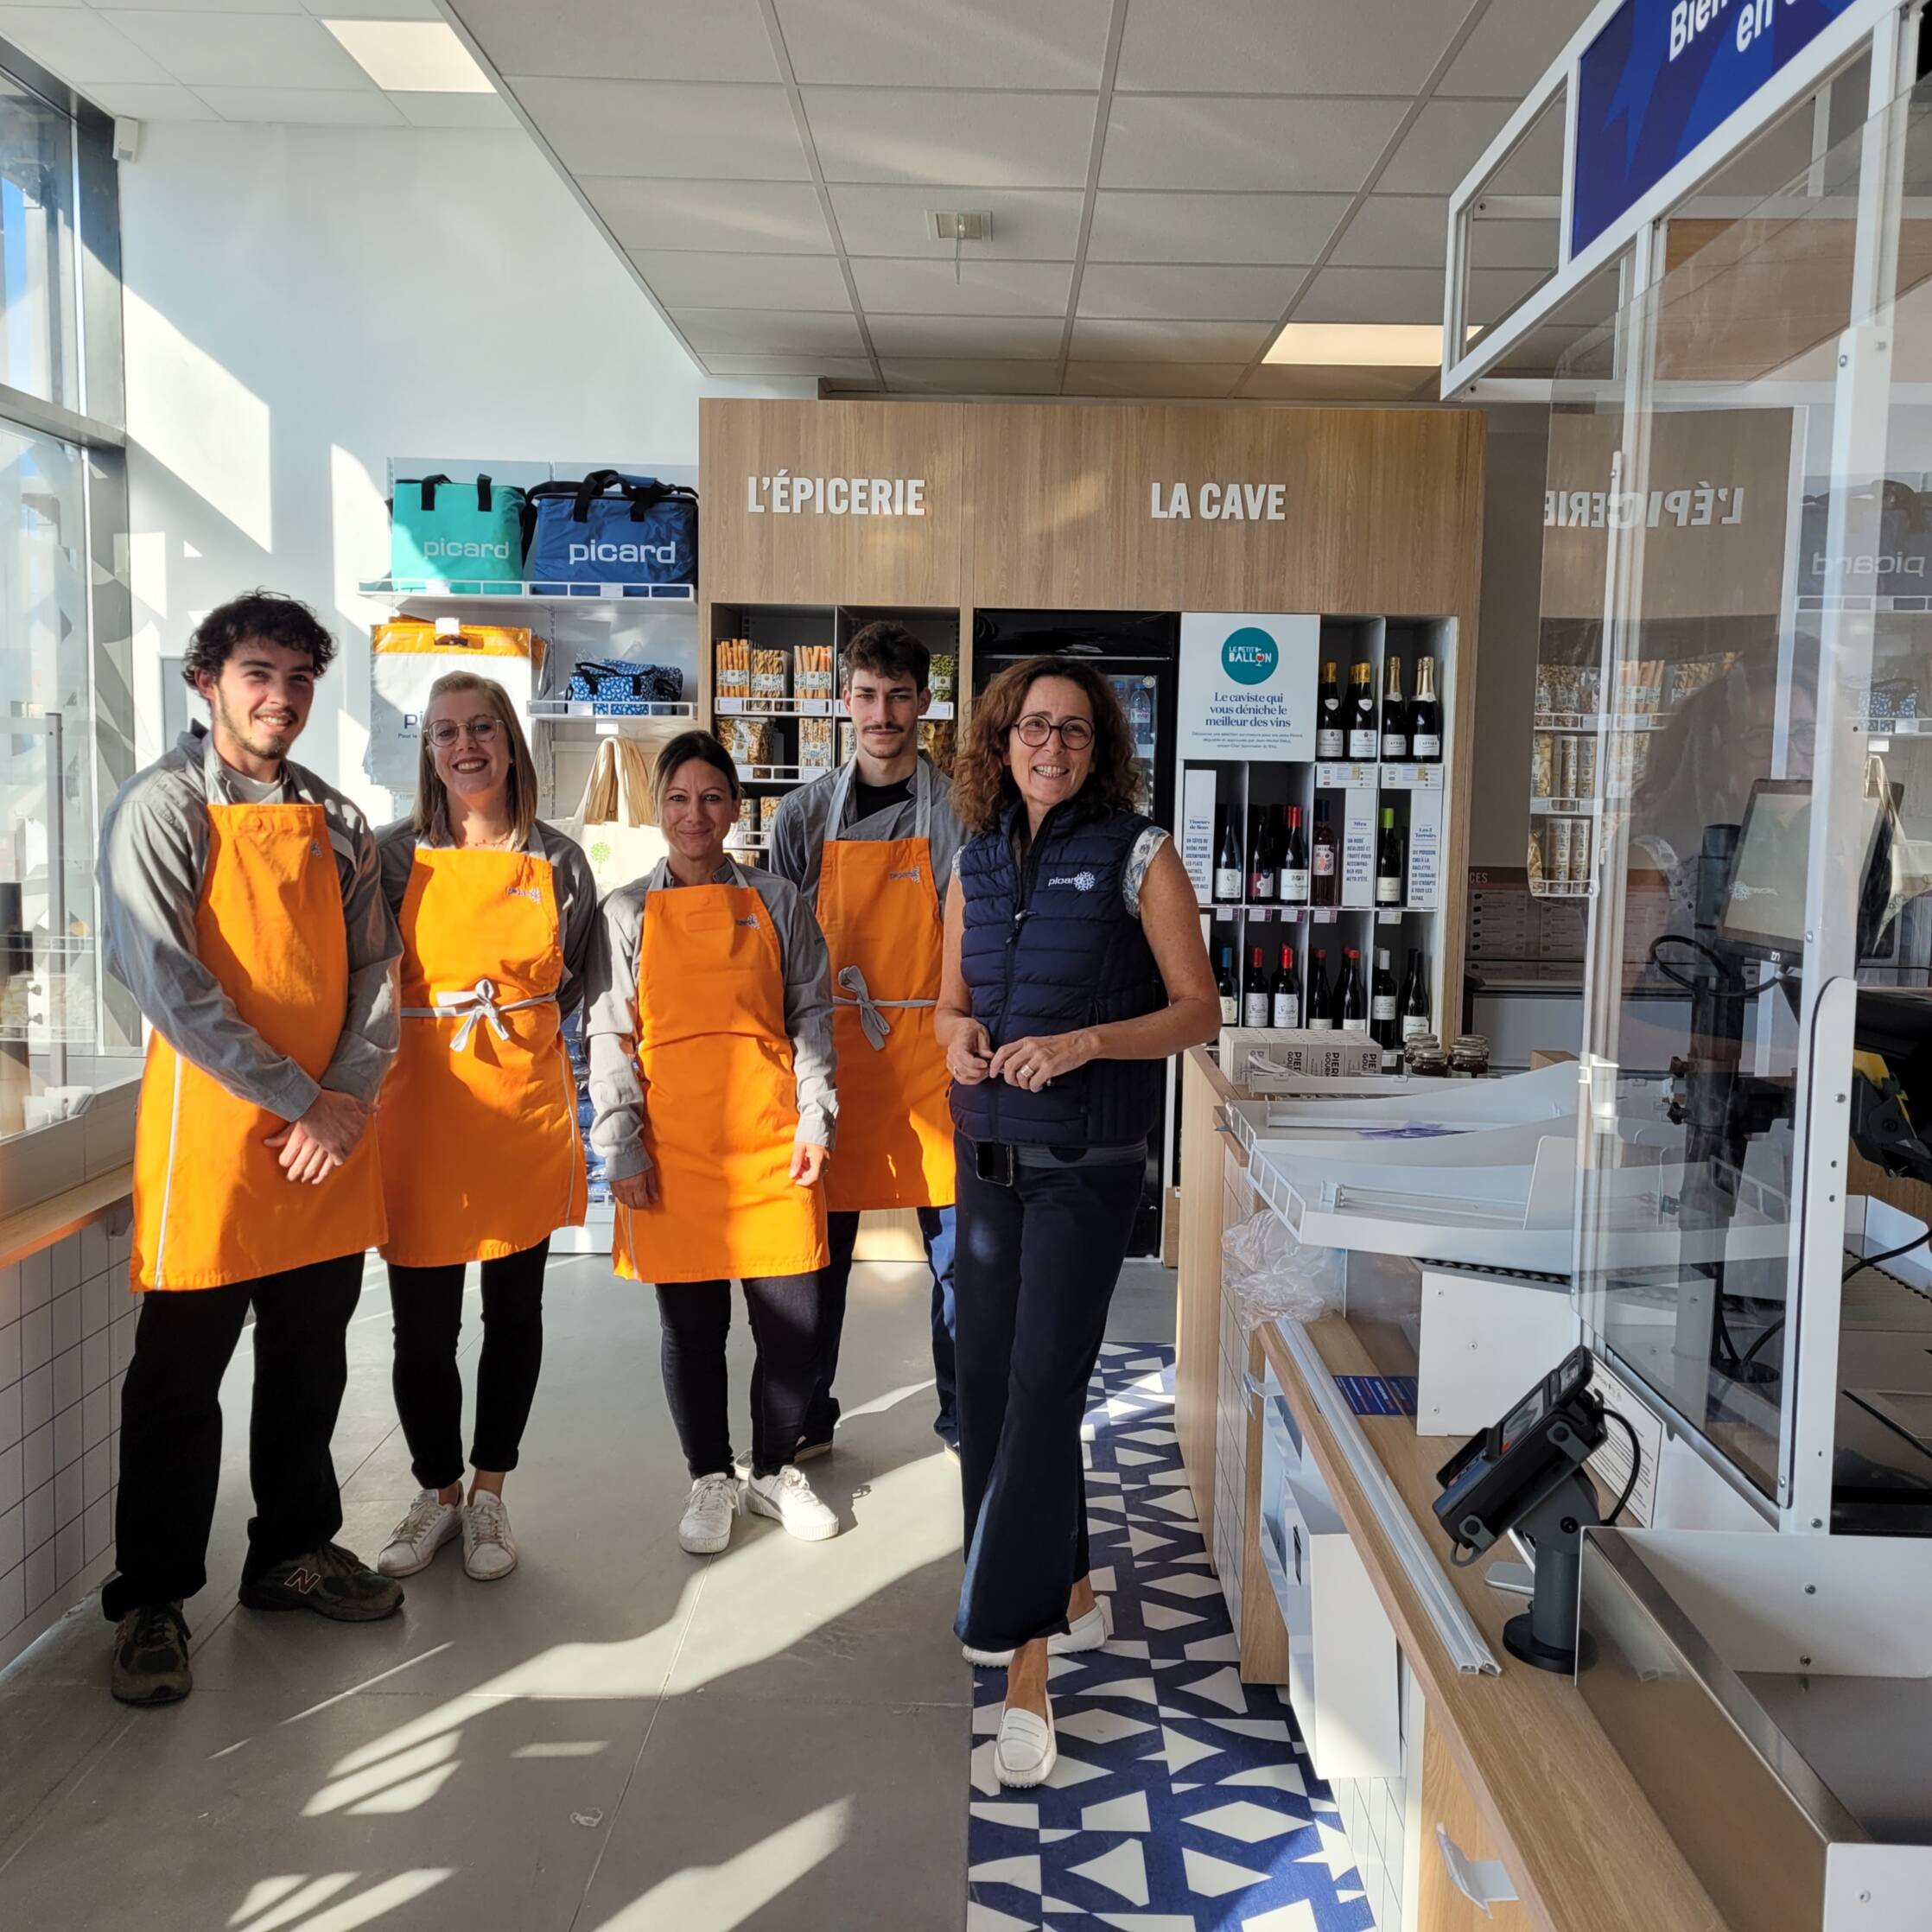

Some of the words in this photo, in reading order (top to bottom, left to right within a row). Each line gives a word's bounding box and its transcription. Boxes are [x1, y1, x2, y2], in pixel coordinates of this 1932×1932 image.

[748, 469, 925, 516] L'ÉPICERIE
[1151, 482, 1192, 519] LA
[1199, 482, 1287, 520] CAVE
[423, 538, 510, 561] picard
[569, 539, 676, 564] picard
[1229, 652, 1272, 664] BALLON
[1210, 706, 1234, 715] vous
[1236, 704, 1277, 715] déniche
[1278, 705, 1287, 715] le
[1215, 692, 1228, 702] Le
[1230, 692, 1265, 702] caviste
[1266, 693, 1284, 705] qui
[1205, 715, 1249, 727] meilleur
[1249, 716, 1268, 727] des
[1269, 717, 1291, 728] vins
[283, 1567, 321, 1595] N
